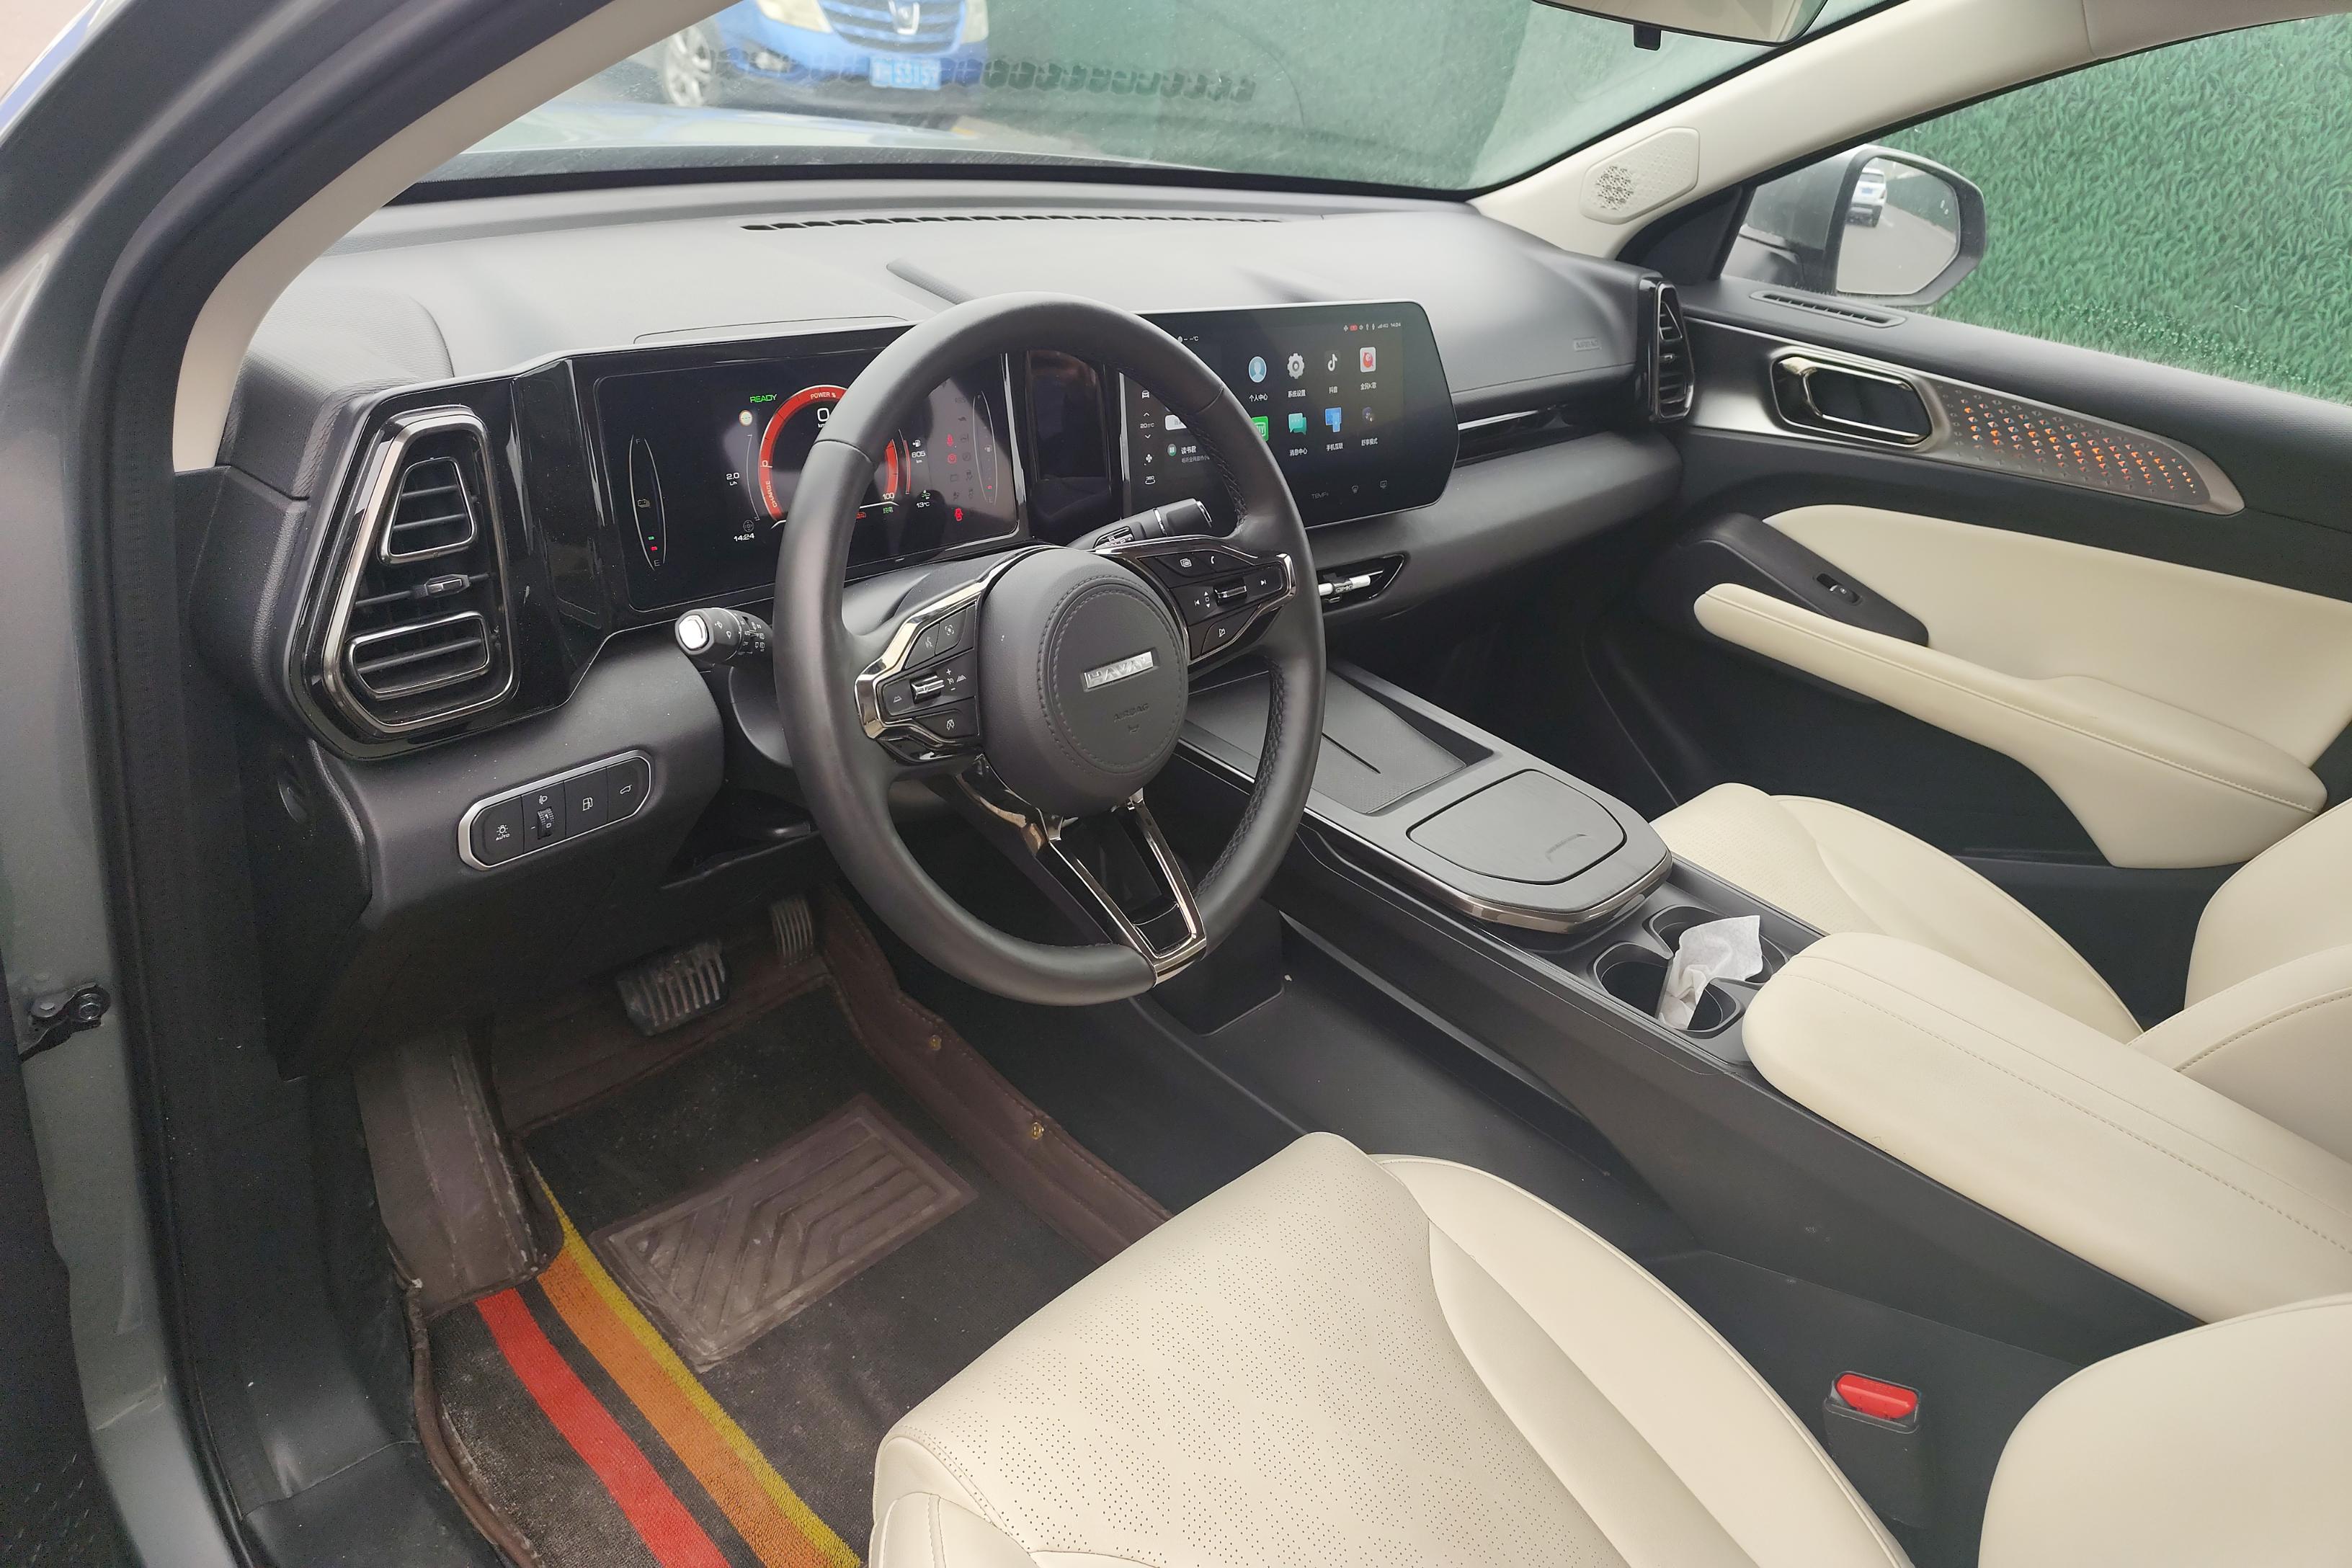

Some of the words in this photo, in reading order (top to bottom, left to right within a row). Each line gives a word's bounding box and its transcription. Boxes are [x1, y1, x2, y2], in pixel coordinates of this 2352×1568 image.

[749, 394, 778, 404] READY
[816, 407, 830, 422] 0
[1289, 447, 1308, 456] 消息中心
[1326, 442, 1344, 452] 手机互联
[726, 472, 740, 481] 2.0
[765, 480, 778, 508] CHARGE
[733, 533, 755, 542] 14:24
